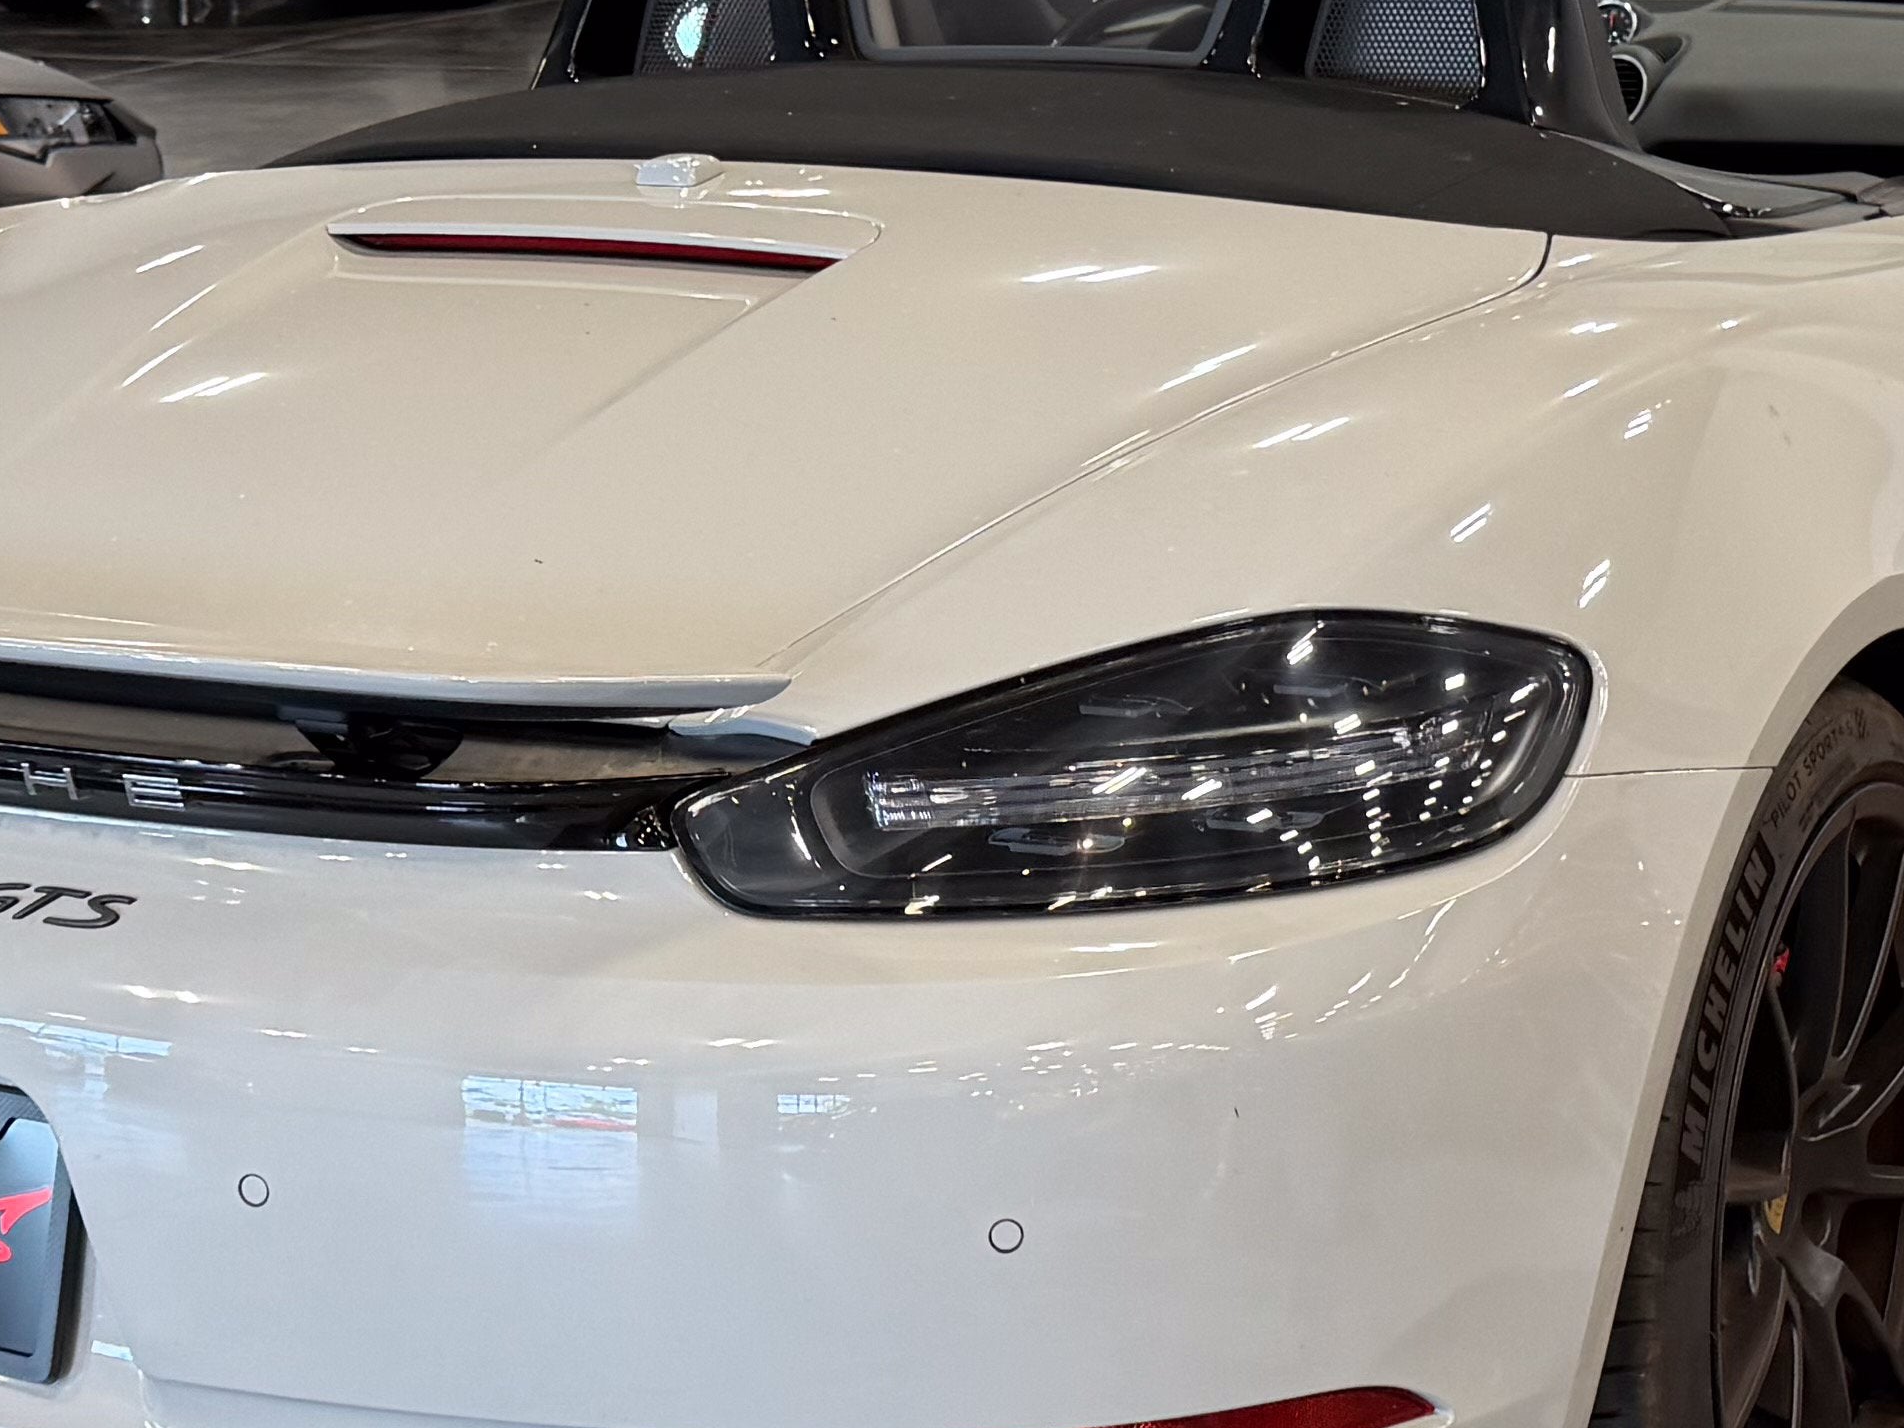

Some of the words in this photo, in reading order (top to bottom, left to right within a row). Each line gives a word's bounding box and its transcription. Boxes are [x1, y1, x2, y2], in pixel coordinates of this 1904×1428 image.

[1769, 770, 1802, 829] PILOT
[1803, 728, 1838, 777] SPORT
[1680, 845, 1771, 1168] MICHELIN
